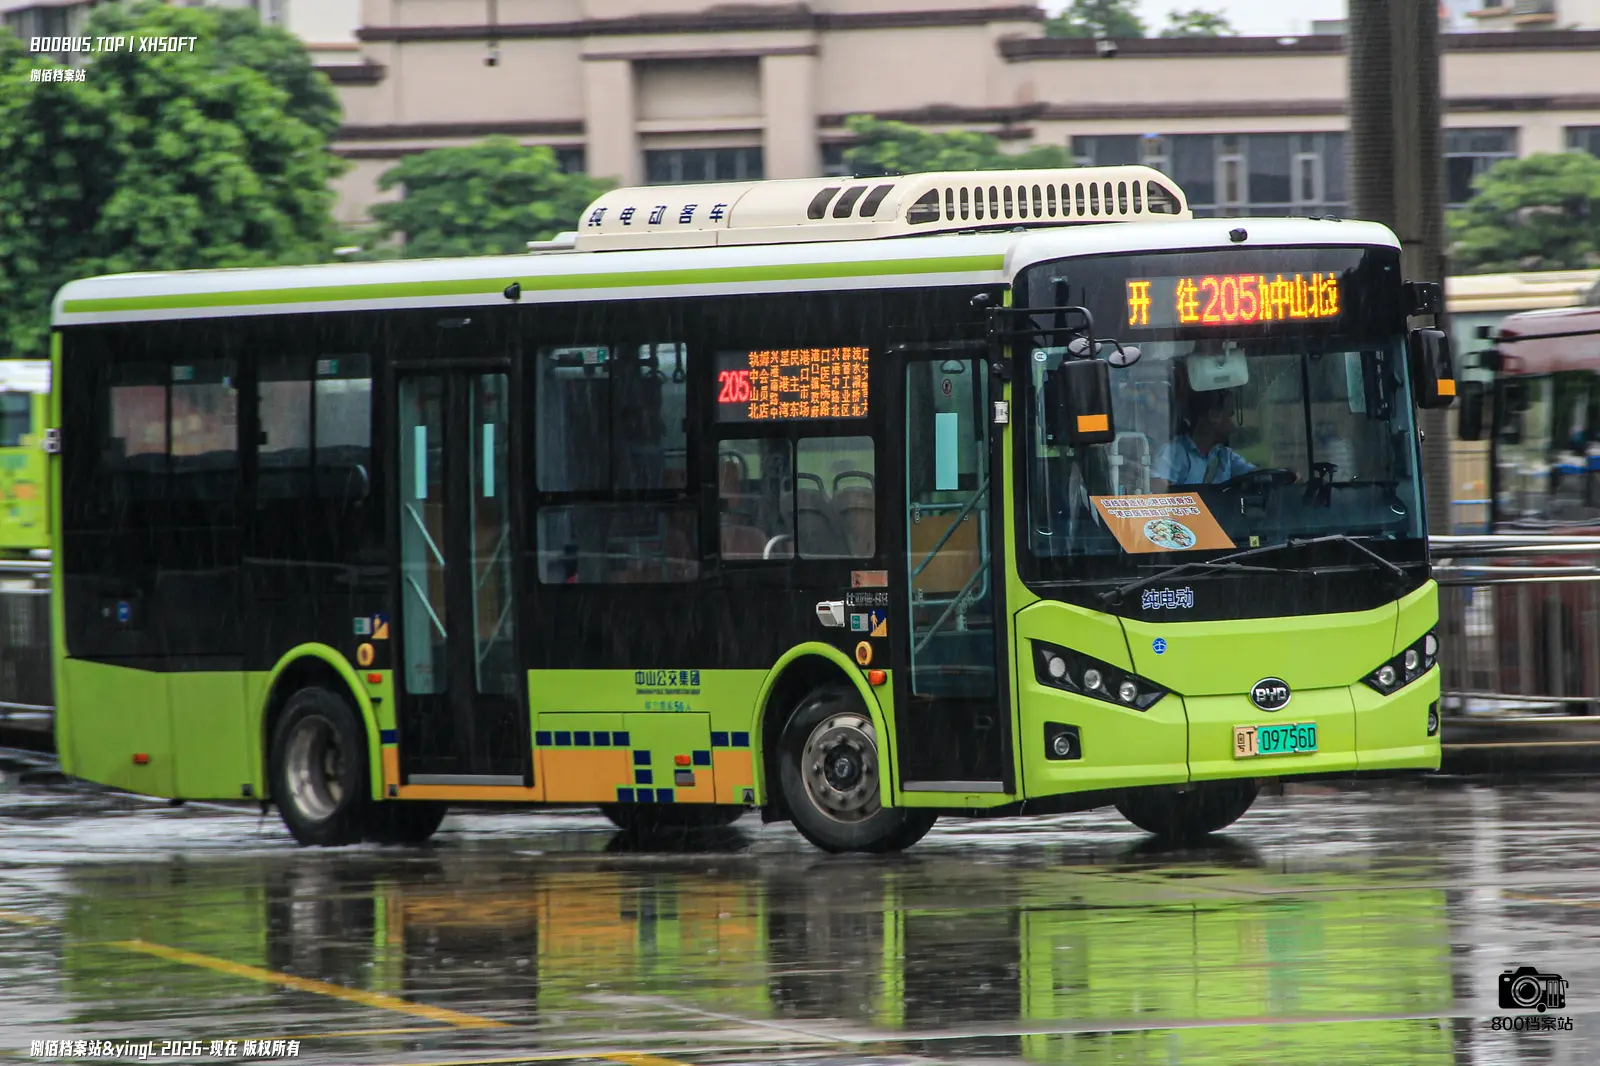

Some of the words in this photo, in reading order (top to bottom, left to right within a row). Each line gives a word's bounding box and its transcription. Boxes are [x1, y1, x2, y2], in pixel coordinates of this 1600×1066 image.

[588, 202, 728, 227] 纯电动客车
[1201, 274, 1259, 325] 205
[717, 370, 750, 403] 205
[1141, 586, 1194, 610] 纯电动
[634, 669, 701, 686] 中山公交集团
[1255, 687, 1287, 702] BYD
[1262, 727, 1317, 751] 09756D
